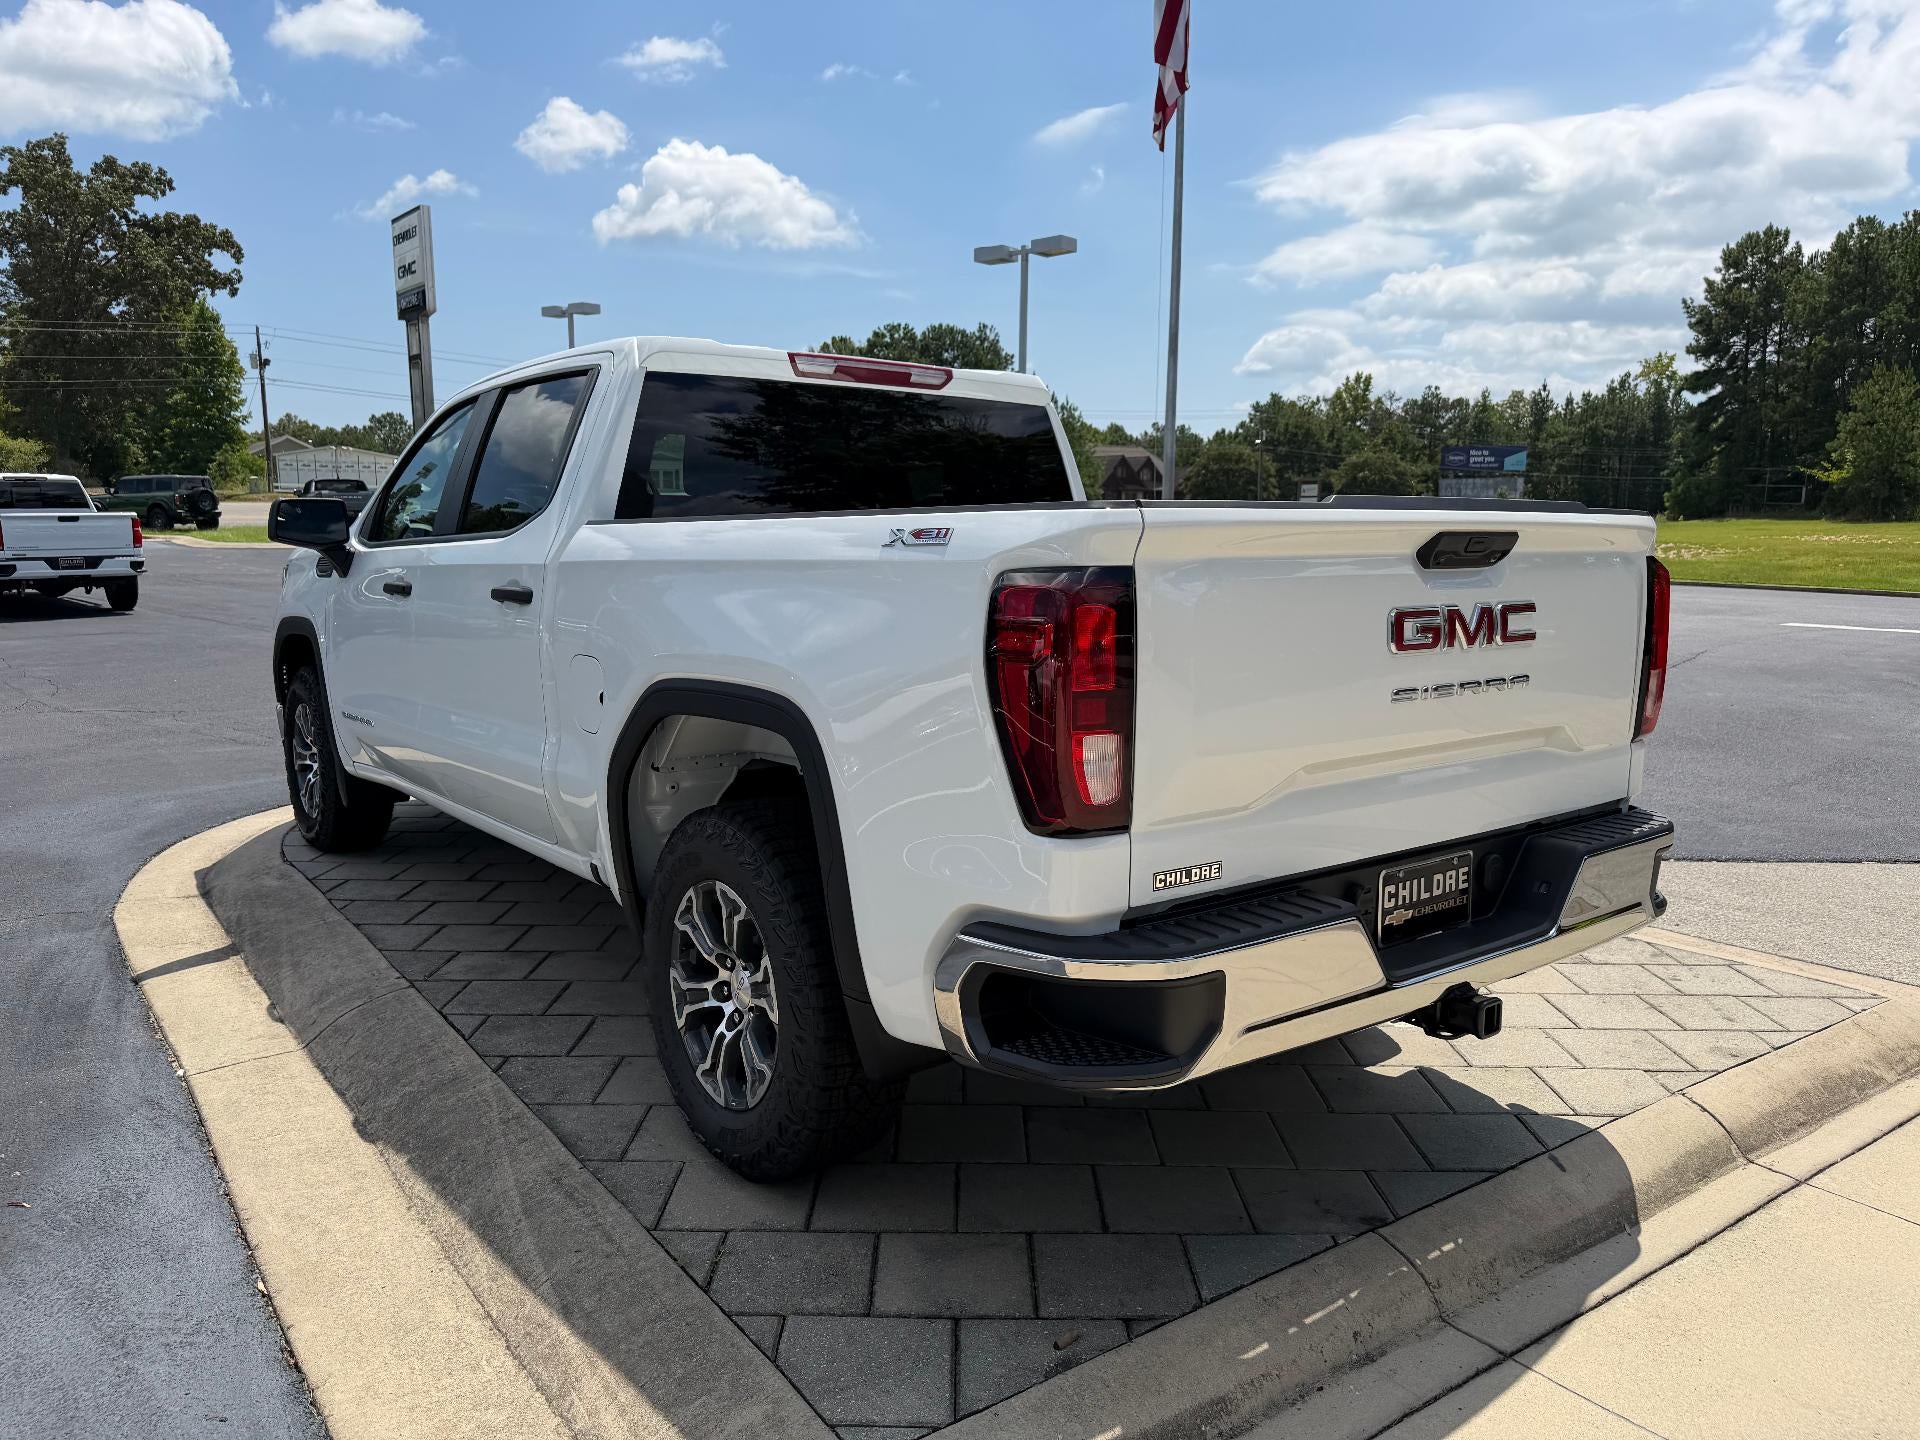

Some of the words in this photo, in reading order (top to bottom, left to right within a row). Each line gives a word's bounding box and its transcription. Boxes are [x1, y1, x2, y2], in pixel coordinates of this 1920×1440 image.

[397, 260, 417, 280] GMC
[1387, 600, 1537, 654] GMC
[1391, 674, 1530, 703] SIERRA
[1415, 895, 1469, 917] CHEVROLET
